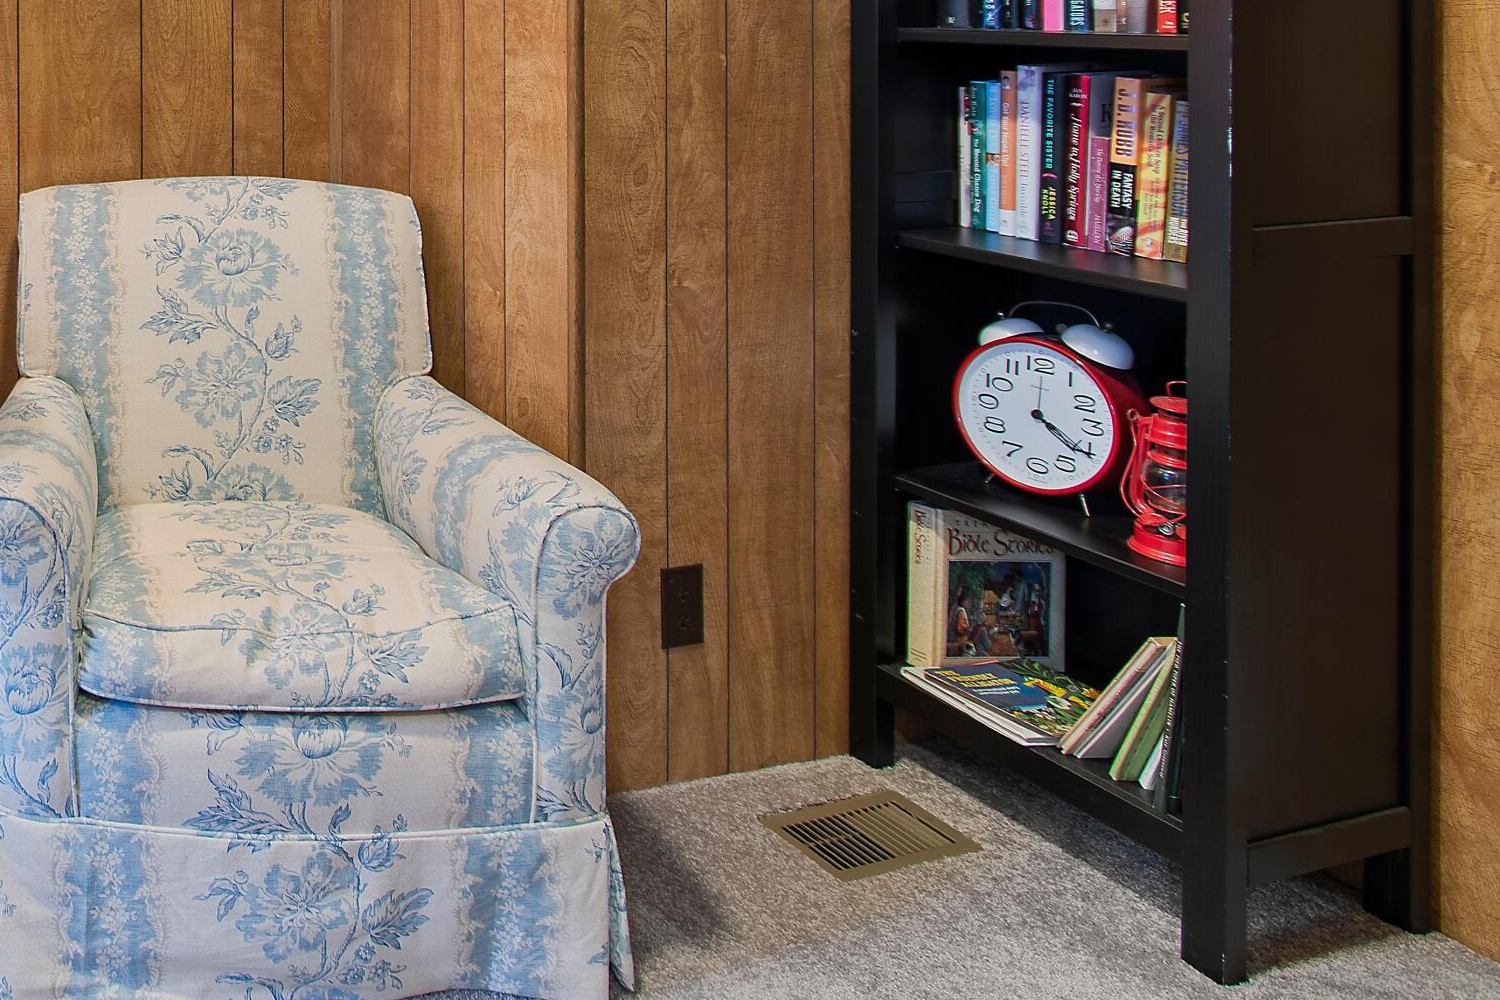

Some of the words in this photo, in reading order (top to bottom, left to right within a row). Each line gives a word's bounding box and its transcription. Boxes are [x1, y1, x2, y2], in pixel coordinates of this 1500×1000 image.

[1047, 79, 1055, 95] THE
[1019, 101, 1030, 150] DANIELLE
[1046, 95, 1054, 138] FAVORITE
[1116, 119, 1137, 158] ROBB
[1045, 139, 1054, 169] SISTER
[1019, 152, 1030, 180] STEEL
[1112, 170, 1122, 181] IN
[973, 173, 981, 198] Chance
[1111, 182, 1121, 208] DEATH
[1121, 172, 1134, 209] FANTASY
[1172, 157, 1188, 216] PATTERSON
[1041, 188, 1049, 215] KNOLL
[1048, 186, 1057, 220] JESSICA
[1067, 185, 1080, 221] Springs
[1006, 358, 1020, 376] 11
[1026, 355, 1055, 376] 12
[986, 373, 1014, 392] 10
[1068, 371, 1073, 388] 1
[978, 393, 999, 410] 9
[1073, 394, 1096, 414] 2
[983, 416, 1006, 434] 8
[1080, 418, 1105, 437] 3
[1001, 440, 1024, 458] 7
[1026, 457, 1049, 475] 6
[1054, 454, 1076, 473] 5
[947, 527, 990, 556] Bible
